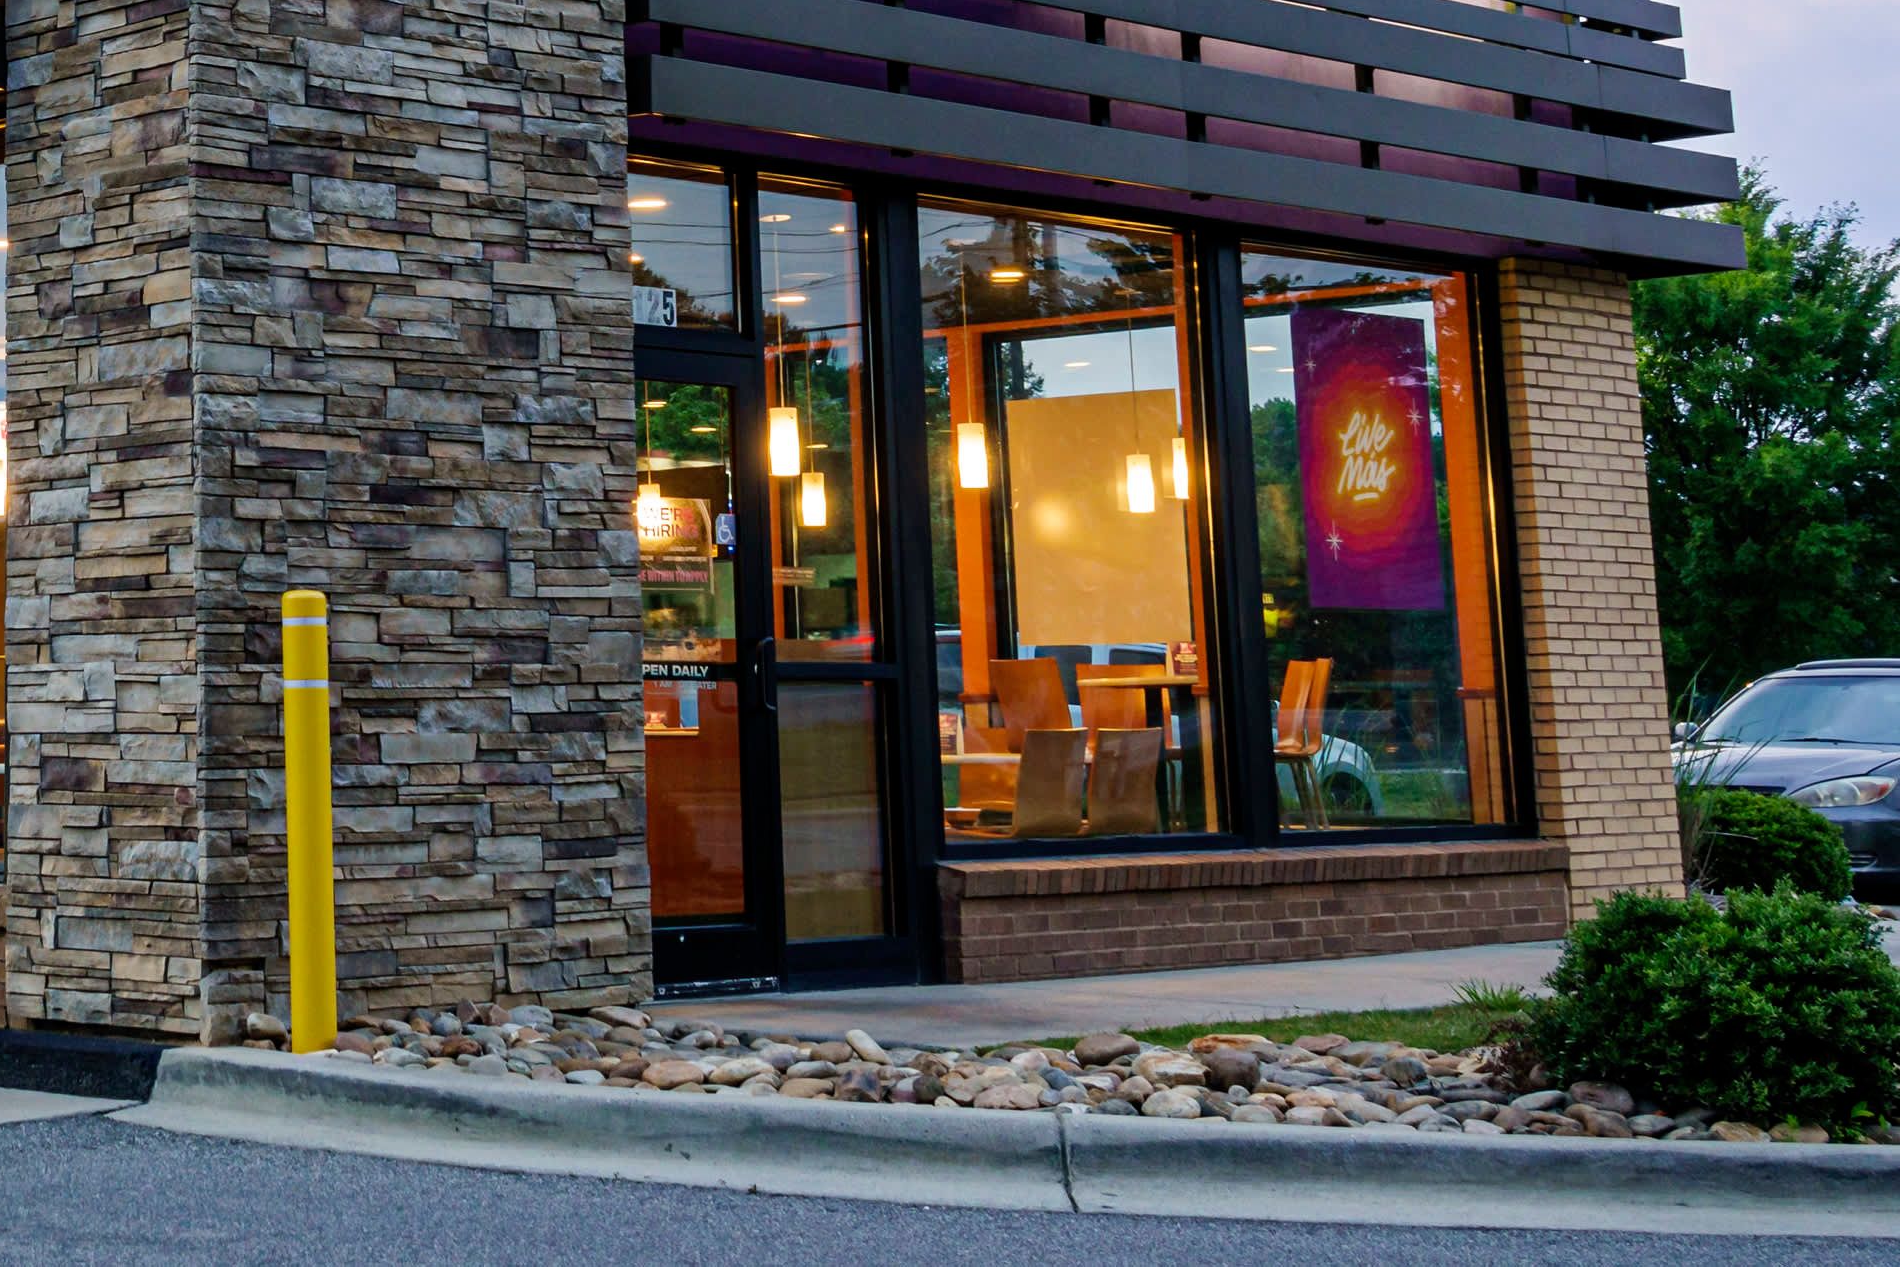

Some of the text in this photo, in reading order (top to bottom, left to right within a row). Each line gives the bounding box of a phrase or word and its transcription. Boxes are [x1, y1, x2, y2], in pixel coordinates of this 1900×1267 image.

[1339, 411, 1395, 456] Live
[1337, 450, 1397, 494] Más
[643, 523, 699, 539] HIRING
[642, 663, 709, 678] PEN DAILY
